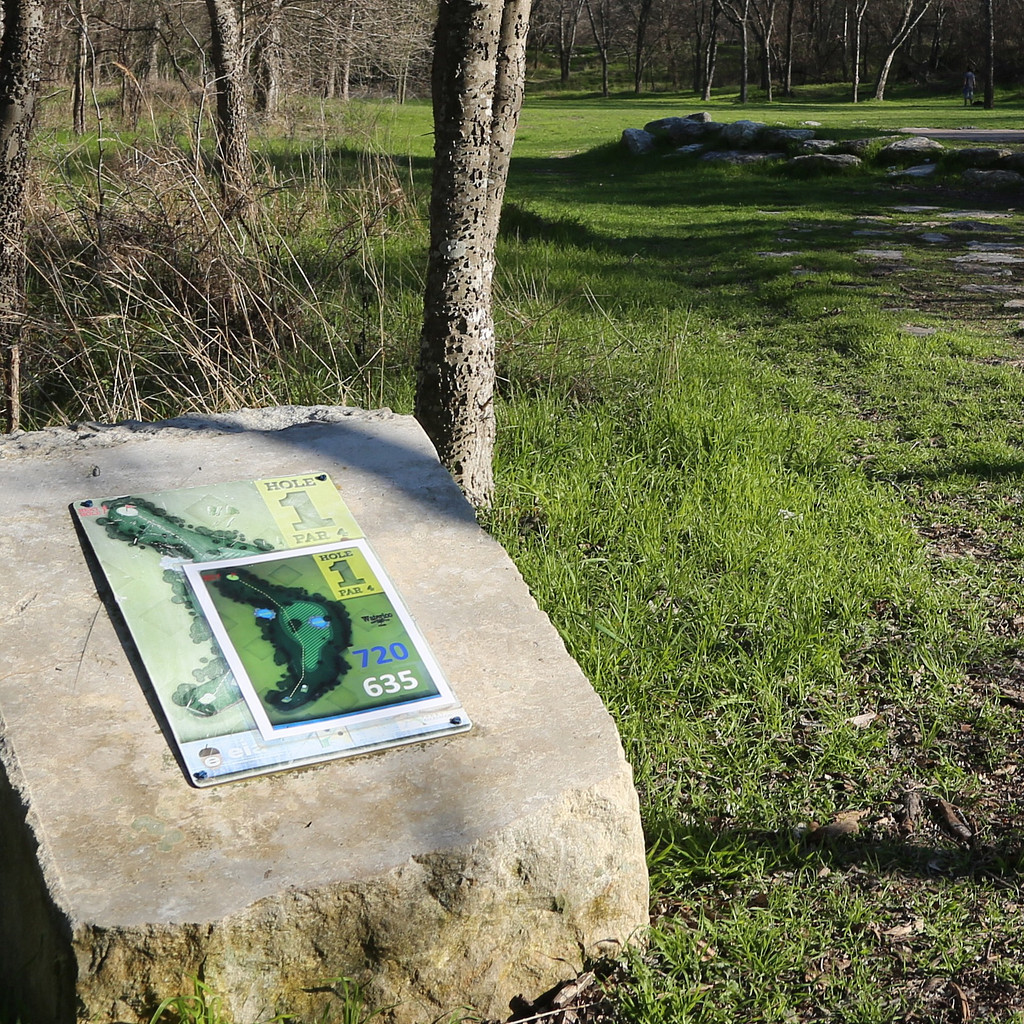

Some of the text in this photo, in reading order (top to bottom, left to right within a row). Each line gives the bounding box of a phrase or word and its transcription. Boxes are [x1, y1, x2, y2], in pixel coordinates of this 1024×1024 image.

[264, 478, 316, 491] HOLE
[279, 490, 336, 531] 1
[293, 528, 349, 544] PAR 4
[320, 551, 353, 561] HOLE
[328, 560, 366, 587] 1
[338, 587, 363, 596] PAR
[352, 642, 409, 668] 720
[363, 670, 418, 697] 635
